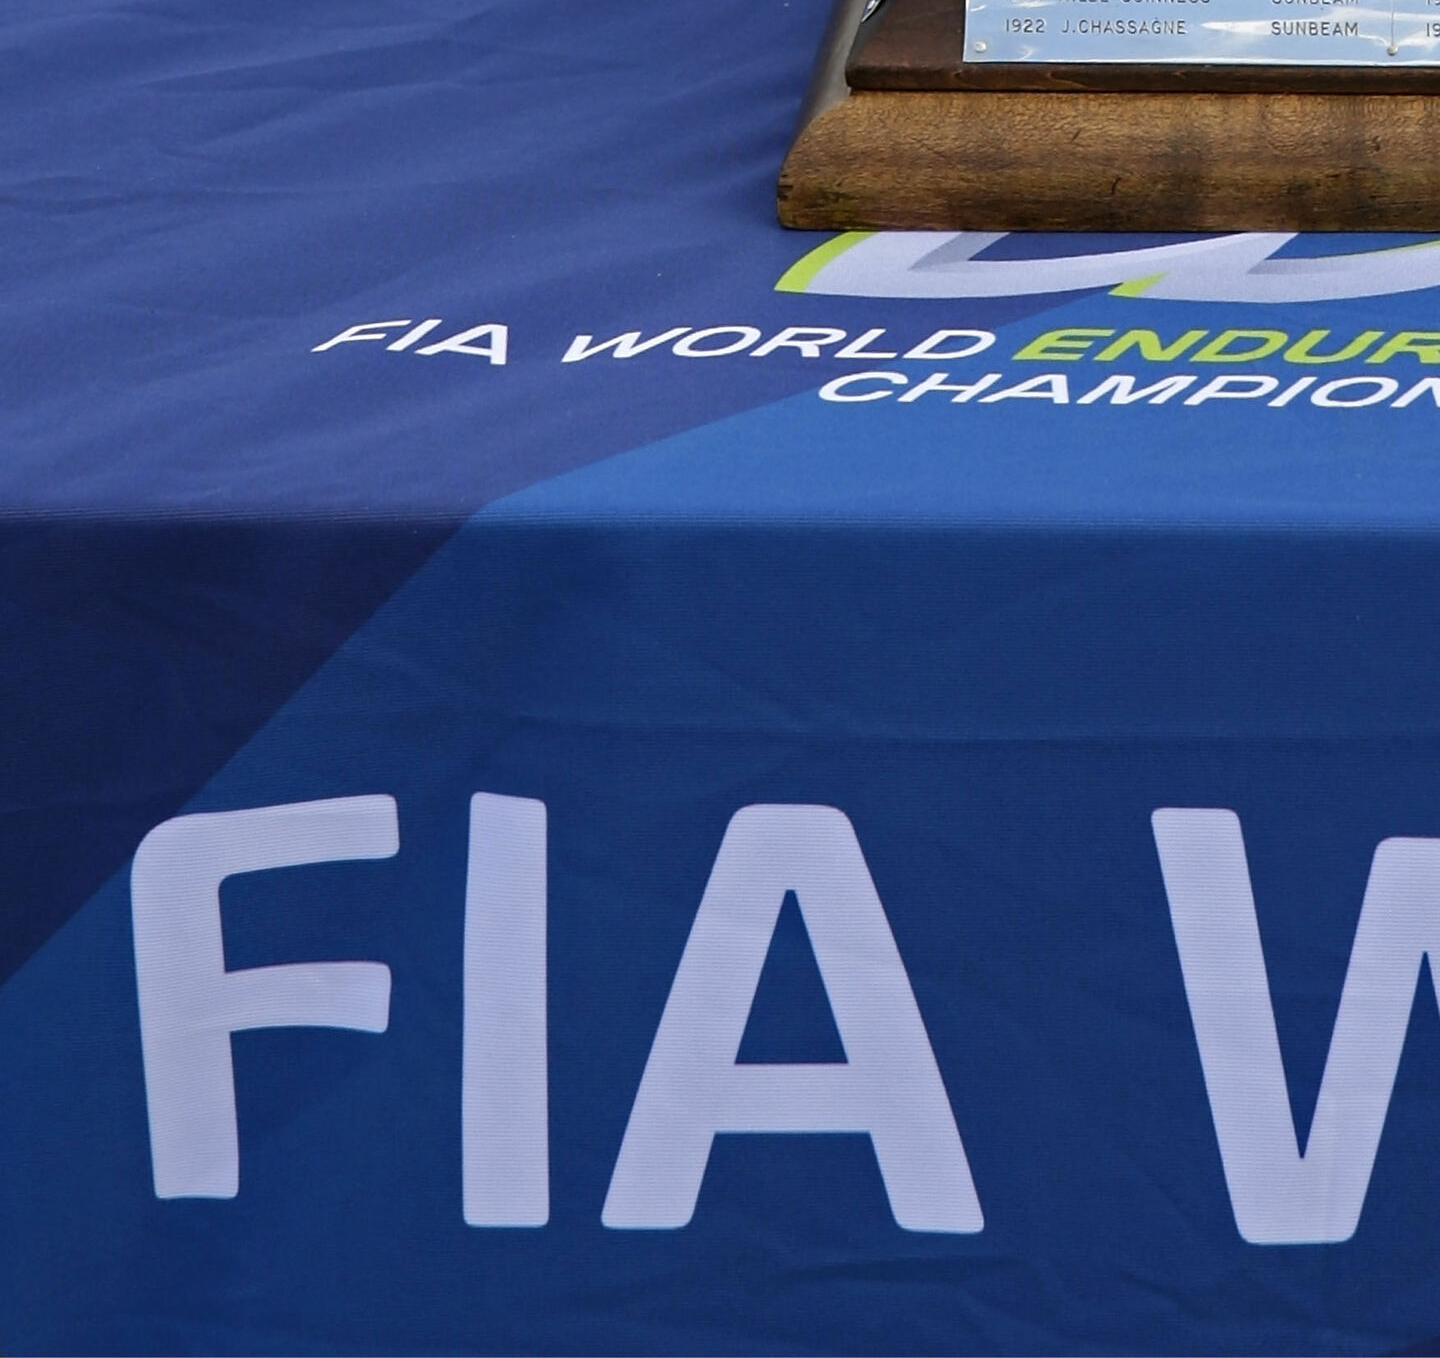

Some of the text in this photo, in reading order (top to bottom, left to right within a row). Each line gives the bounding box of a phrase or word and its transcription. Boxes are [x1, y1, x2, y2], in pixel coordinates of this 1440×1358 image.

[1005, 18, 1359, 36] 1922 J.CHASSAGNE SUNBEAM
[311, 319, 507, 365] FIA
[561, 326, 996, 362] WORLD
[131, 792, 985, 1234] FIA
